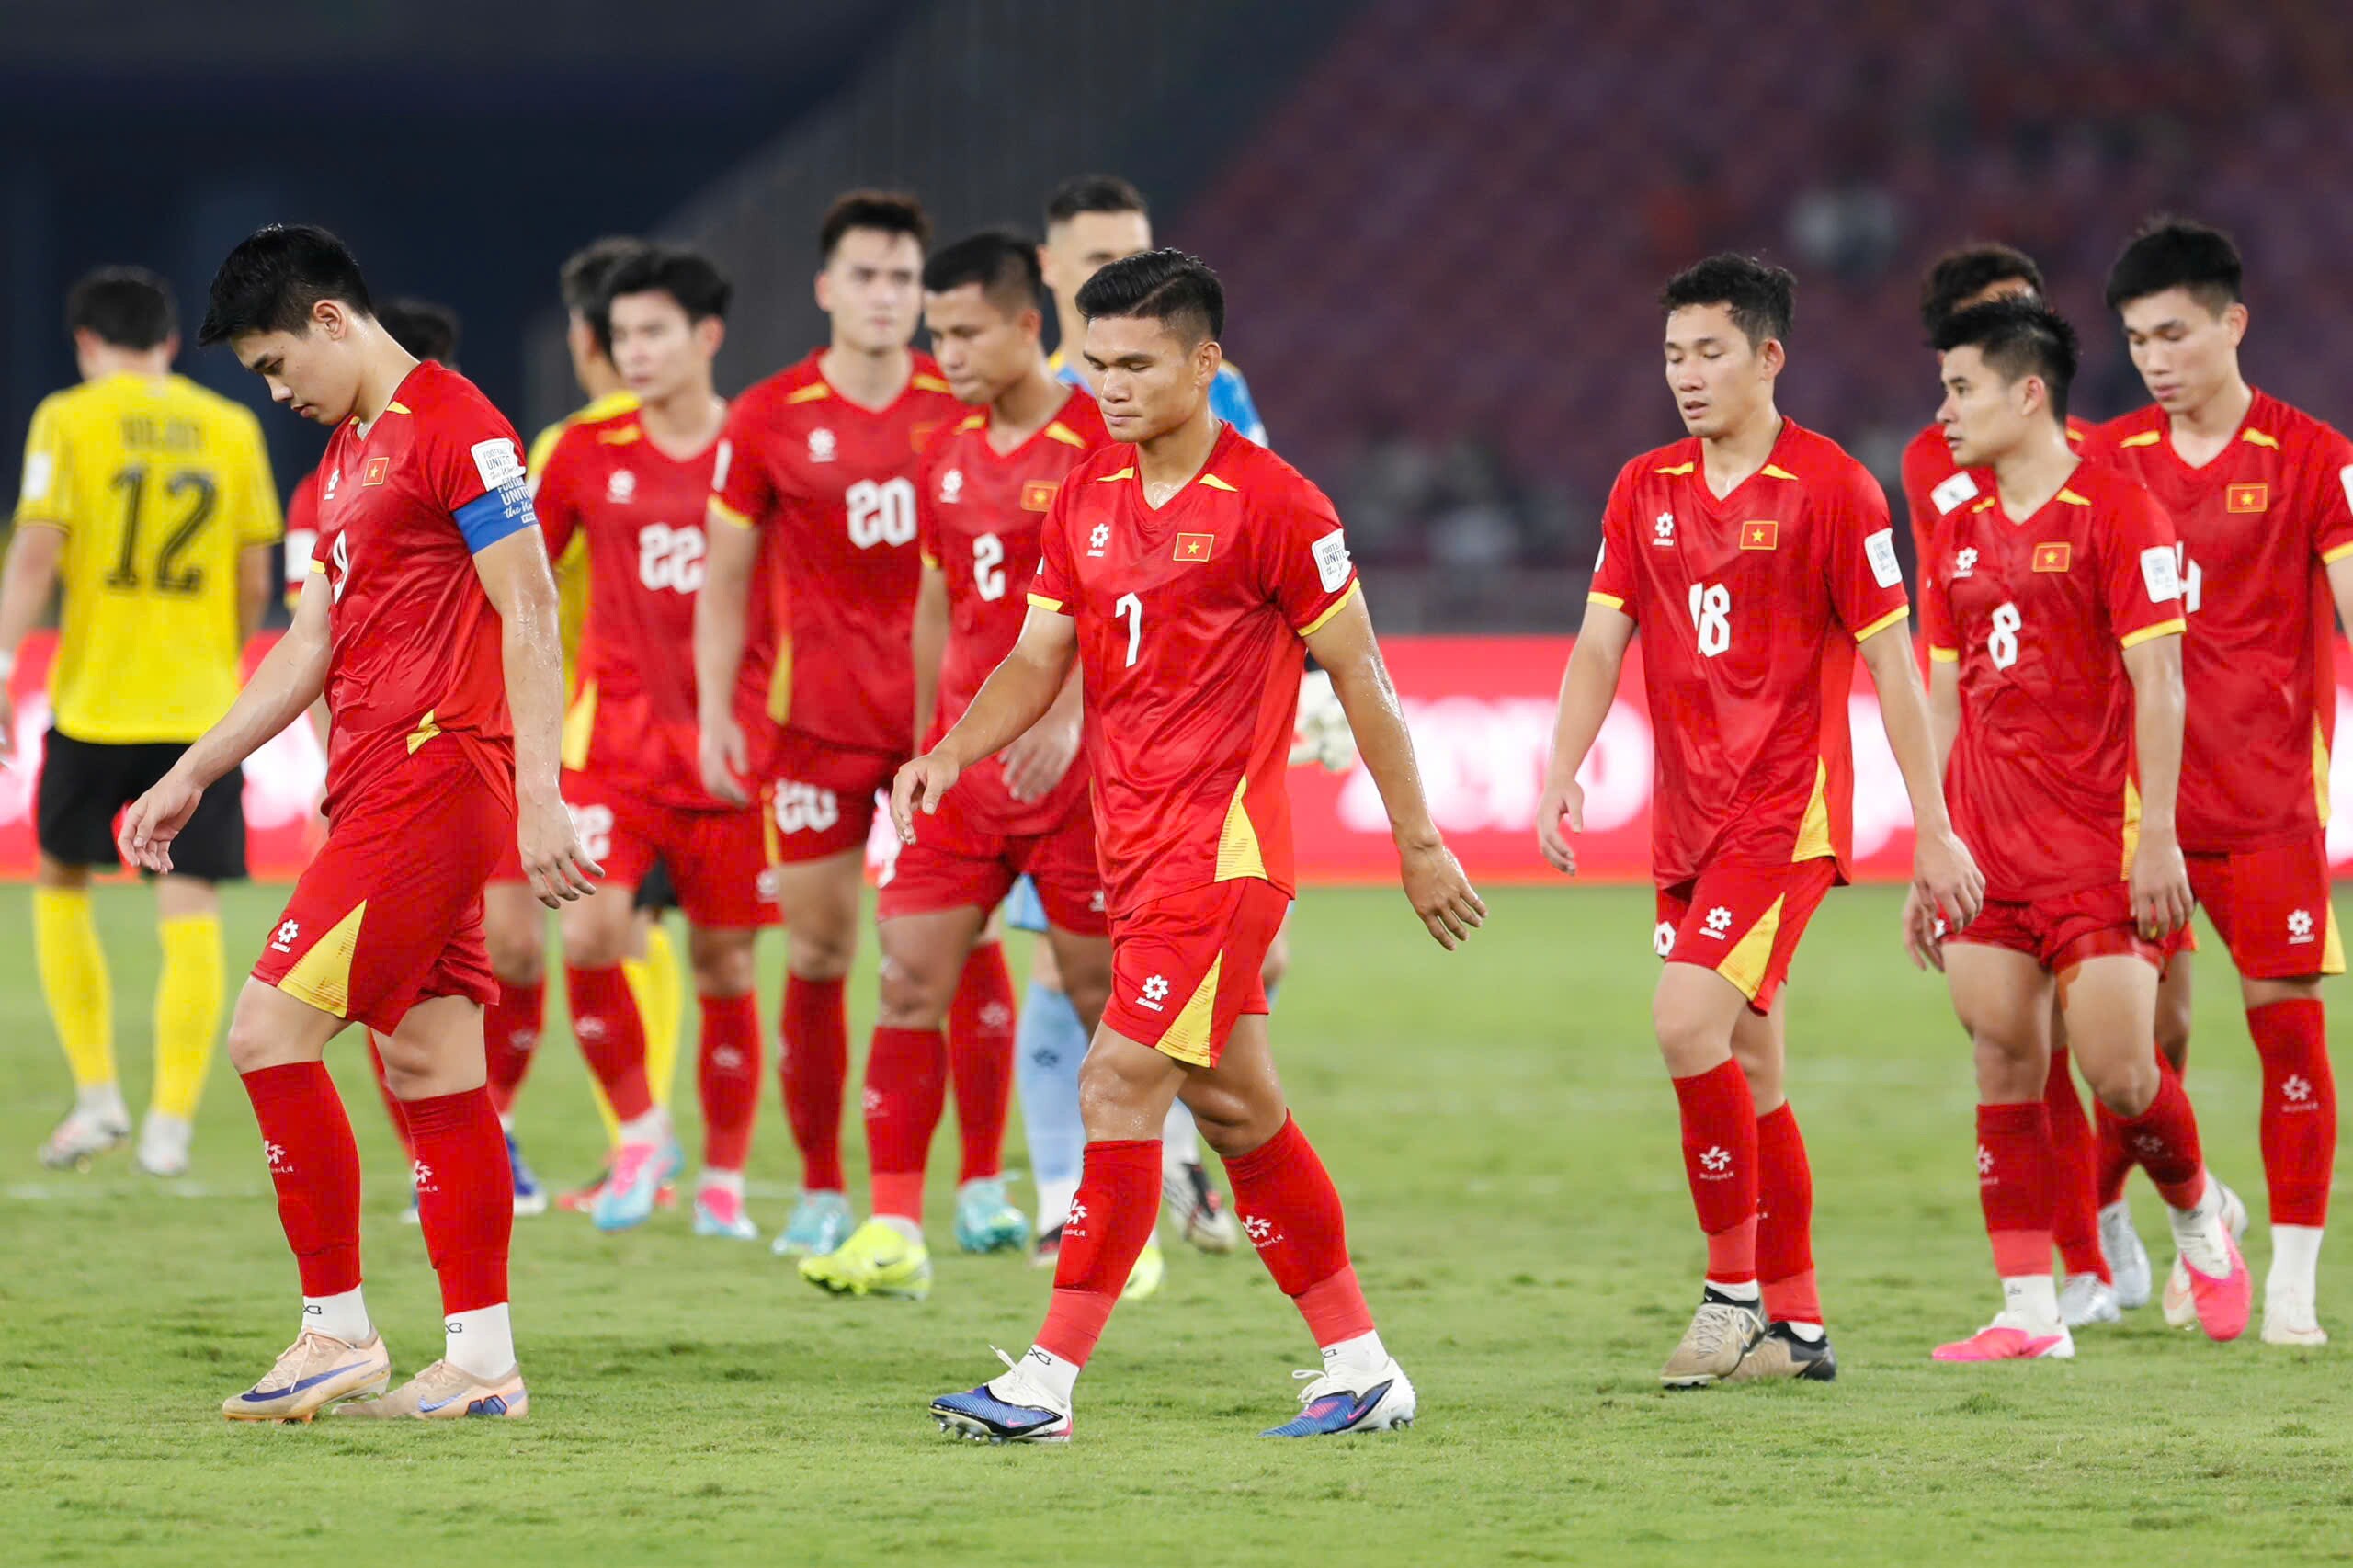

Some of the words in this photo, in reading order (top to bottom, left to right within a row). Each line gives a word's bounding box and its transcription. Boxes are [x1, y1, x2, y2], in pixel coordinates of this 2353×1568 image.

[105, 462, 218, 594] 12
[846, 476, 918, 550] 20
[638, 521, 706, 595] 22
[972, 532, 1006, 602] 2
[1115, 591, 1142, 669] 7
[1688, 581, 1731, 658] 18
[1987, 600, 2022, 673] 8
